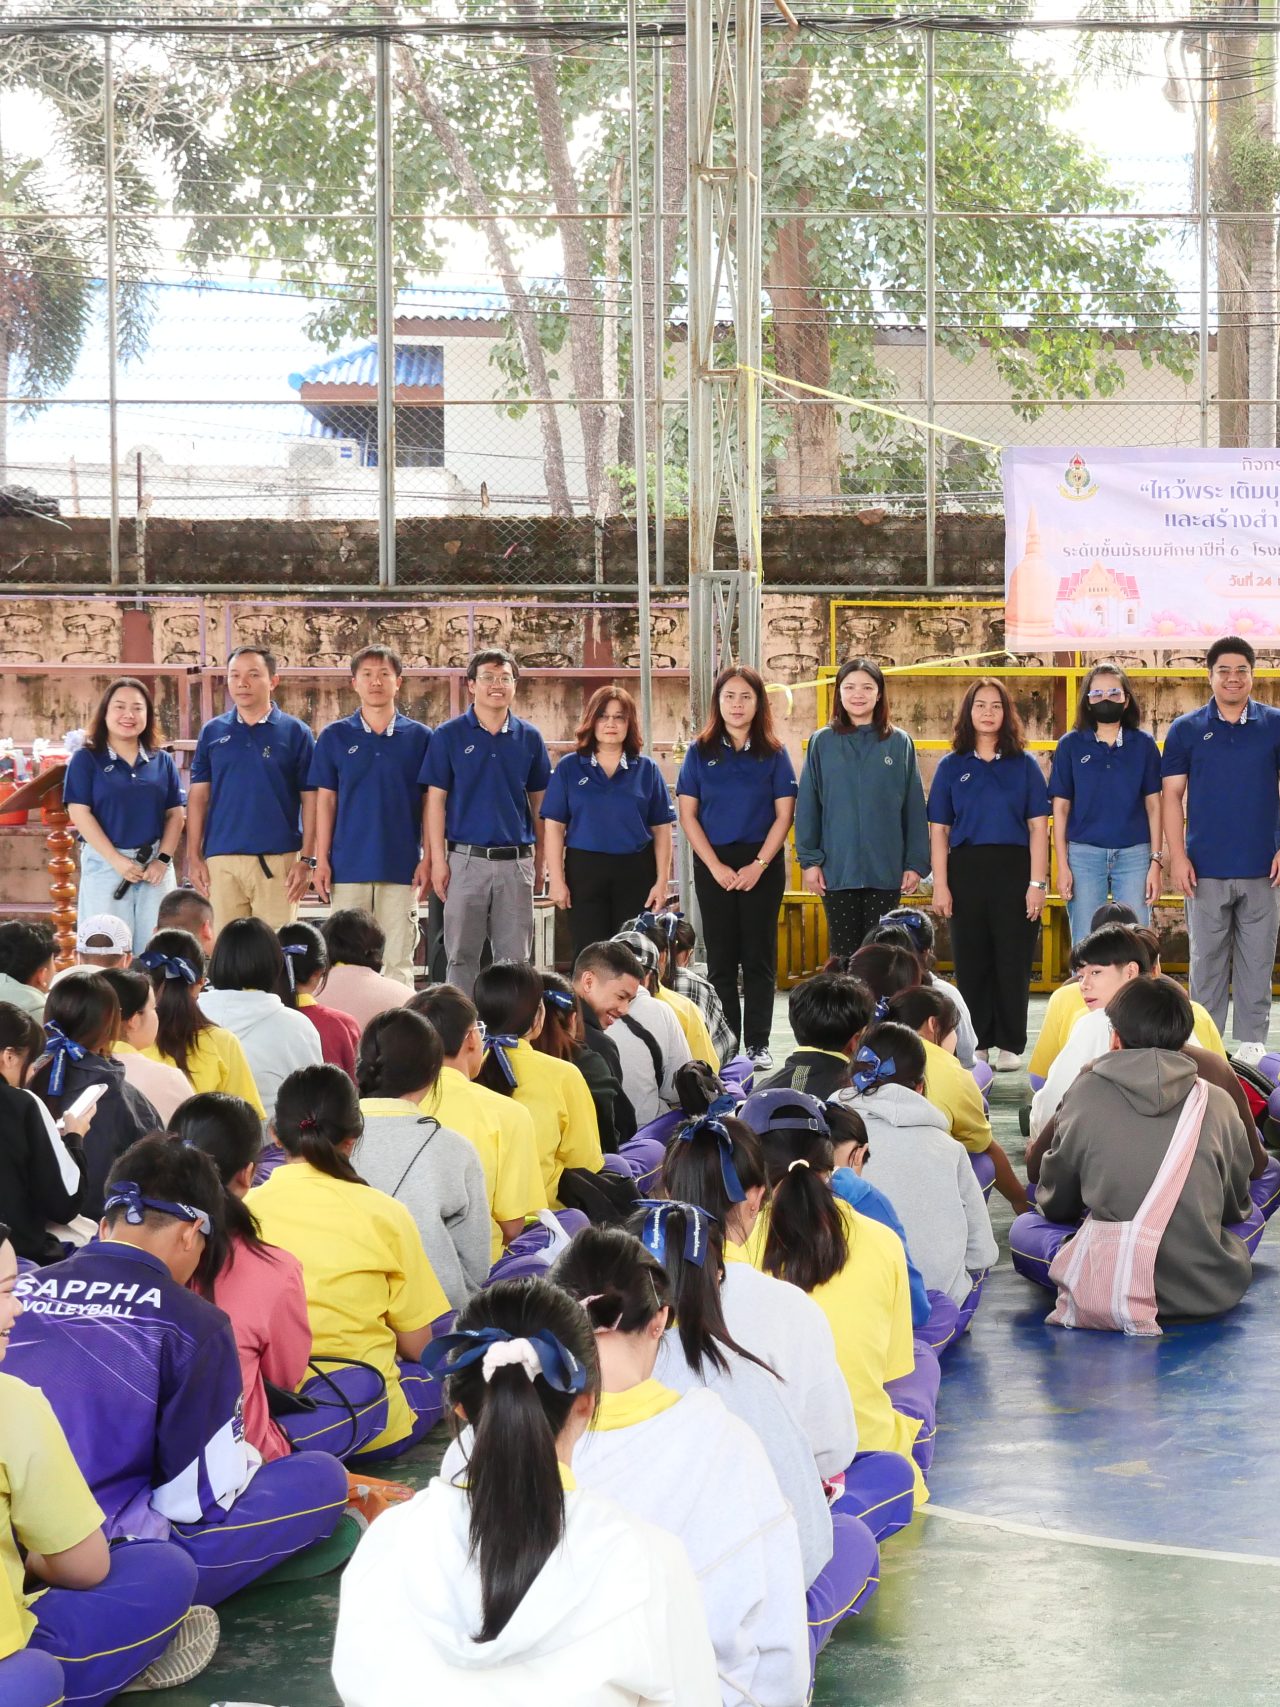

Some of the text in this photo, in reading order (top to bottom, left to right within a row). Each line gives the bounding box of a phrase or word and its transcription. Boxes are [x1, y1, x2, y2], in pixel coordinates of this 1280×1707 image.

[1063, 538, 1225, 557] ระดับชั้นมัธยมศึกษาปีที่
[1230, 545, 1240, 557] 6
[1229, 572, 1254, 587] วันที่
[1256, 576, 1273, 587] 24
[11, 1278, 161, 1309] SAPPHA
[22, 1299, 136, 1319] VOLLEYBALL
